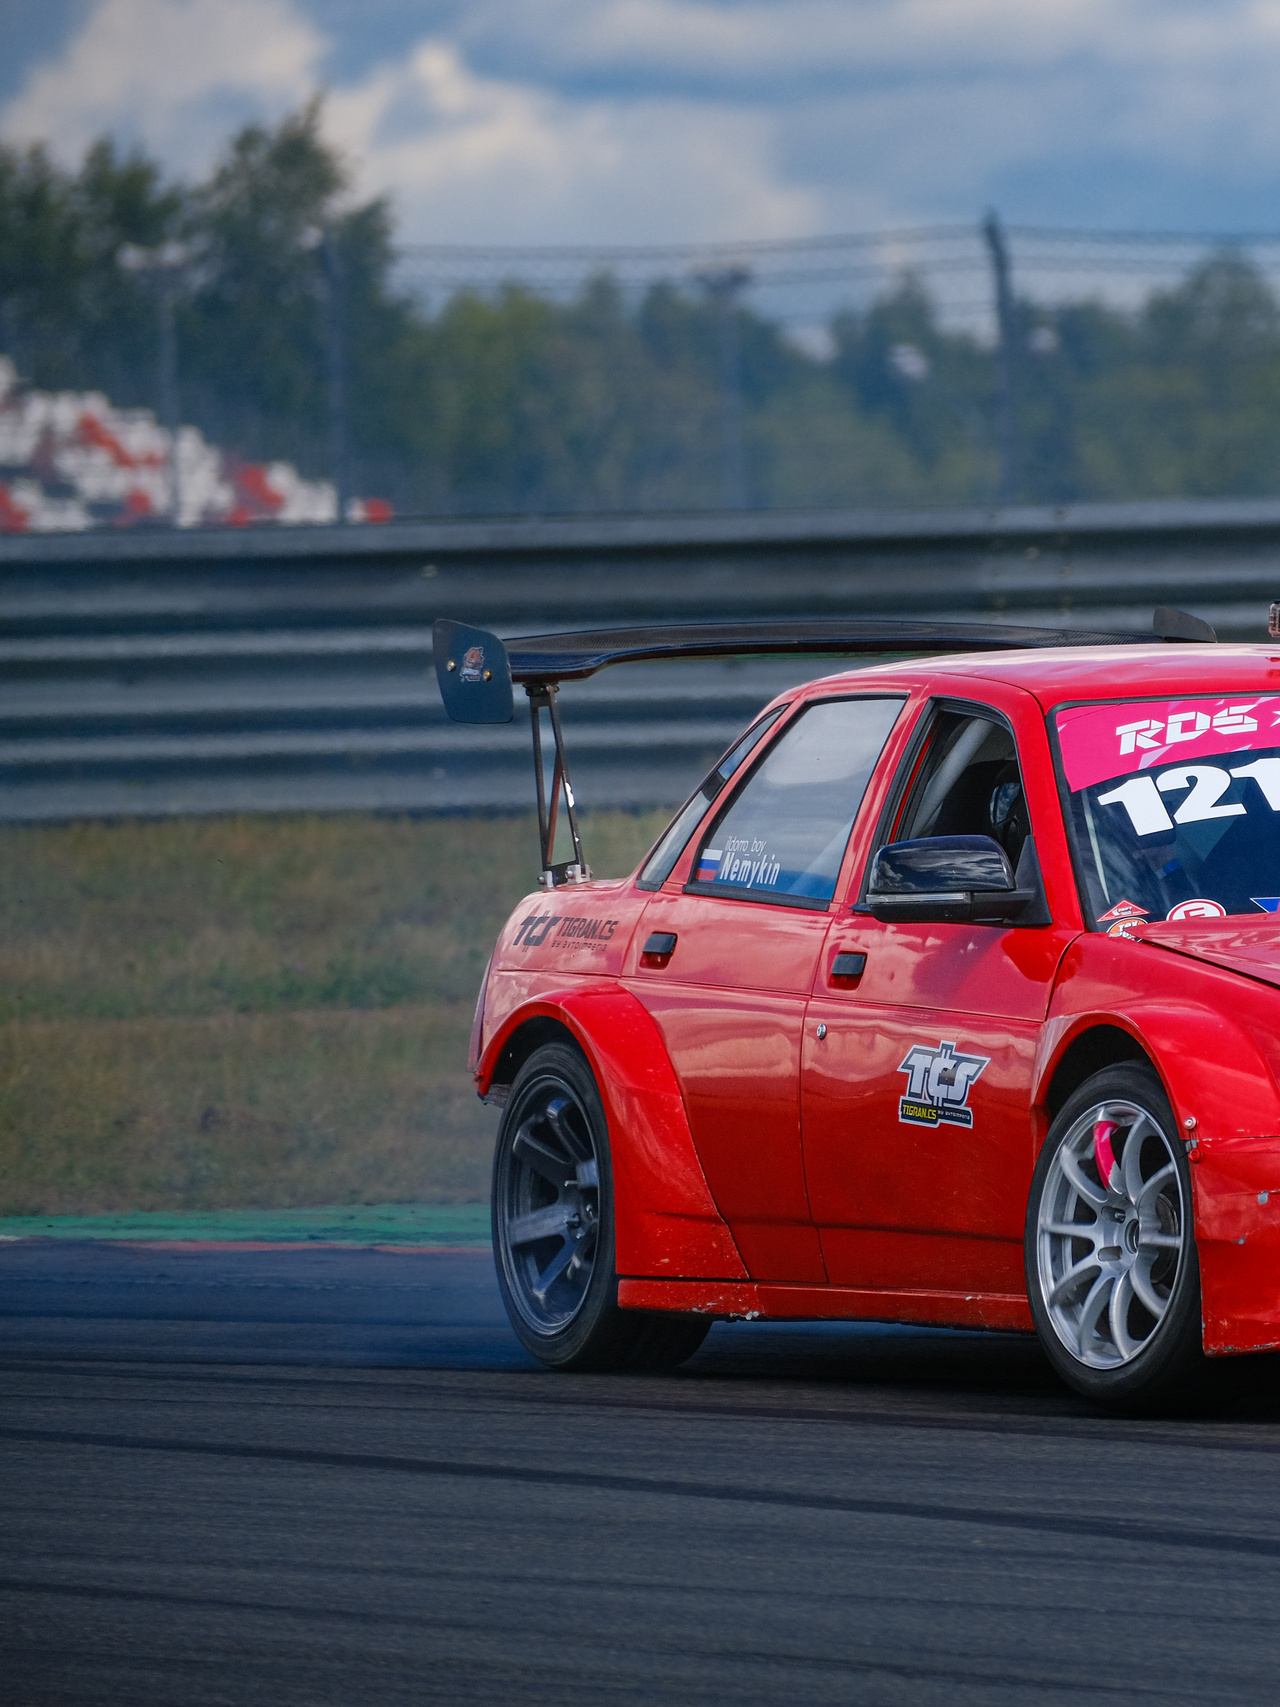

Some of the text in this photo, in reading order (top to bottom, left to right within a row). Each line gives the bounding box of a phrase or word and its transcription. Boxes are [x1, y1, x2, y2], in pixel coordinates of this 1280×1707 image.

[1116, 704, 1258, 755] RDS
[719, 851, 780, 889] Nemykin
[556, 917, 619, 940] TIGRAN.CS
[907, 1048, 981, 1106] TCS
[903, 1104, 937, 1120] TIGRAN.CS
